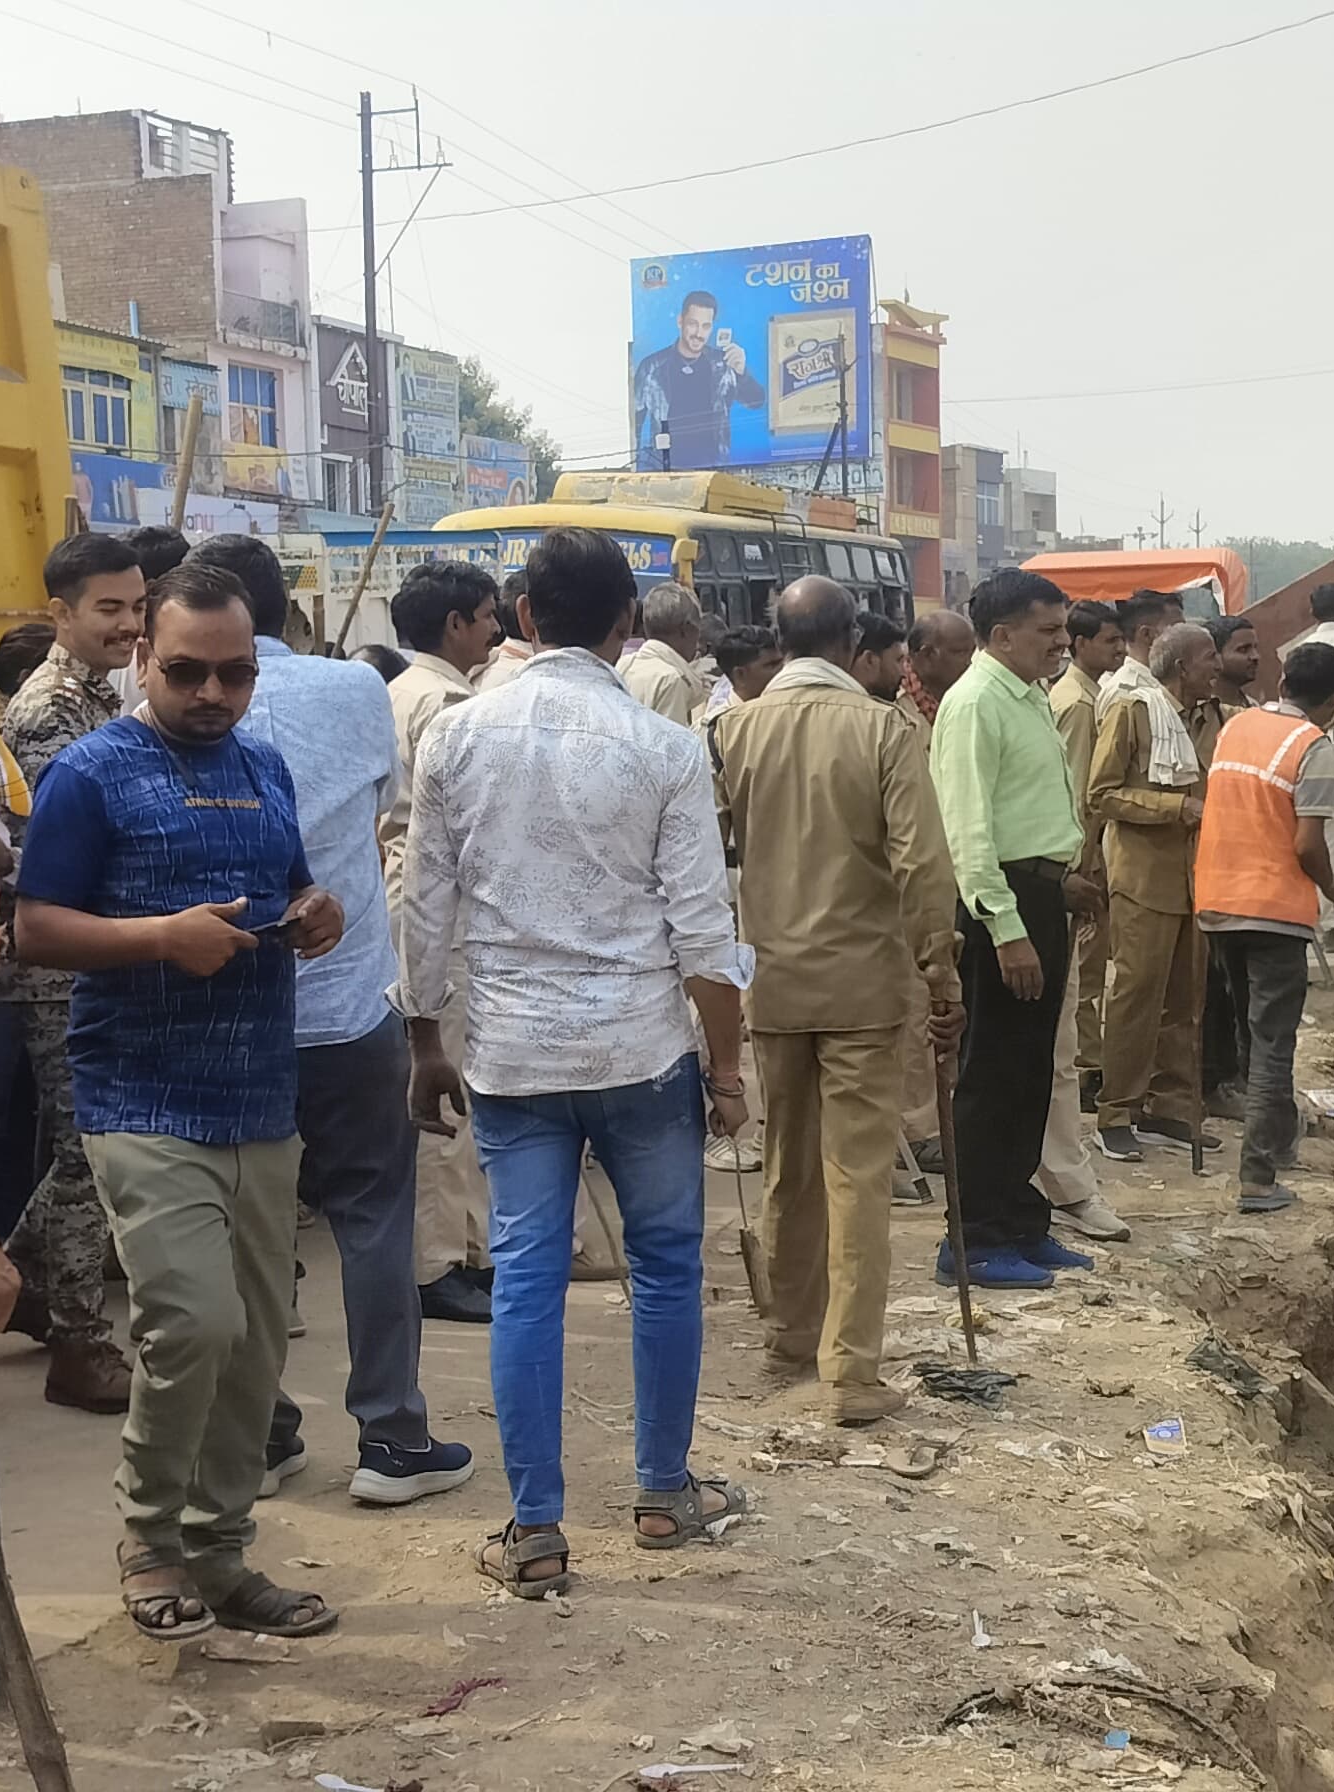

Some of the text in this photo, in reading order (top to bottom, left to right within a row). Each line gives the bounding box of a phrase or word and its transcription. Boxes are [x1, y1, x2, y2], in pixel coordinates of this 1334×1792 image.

[744, 258, 840, 287] टशन का
[789, 278, 851, 304] जश्न
